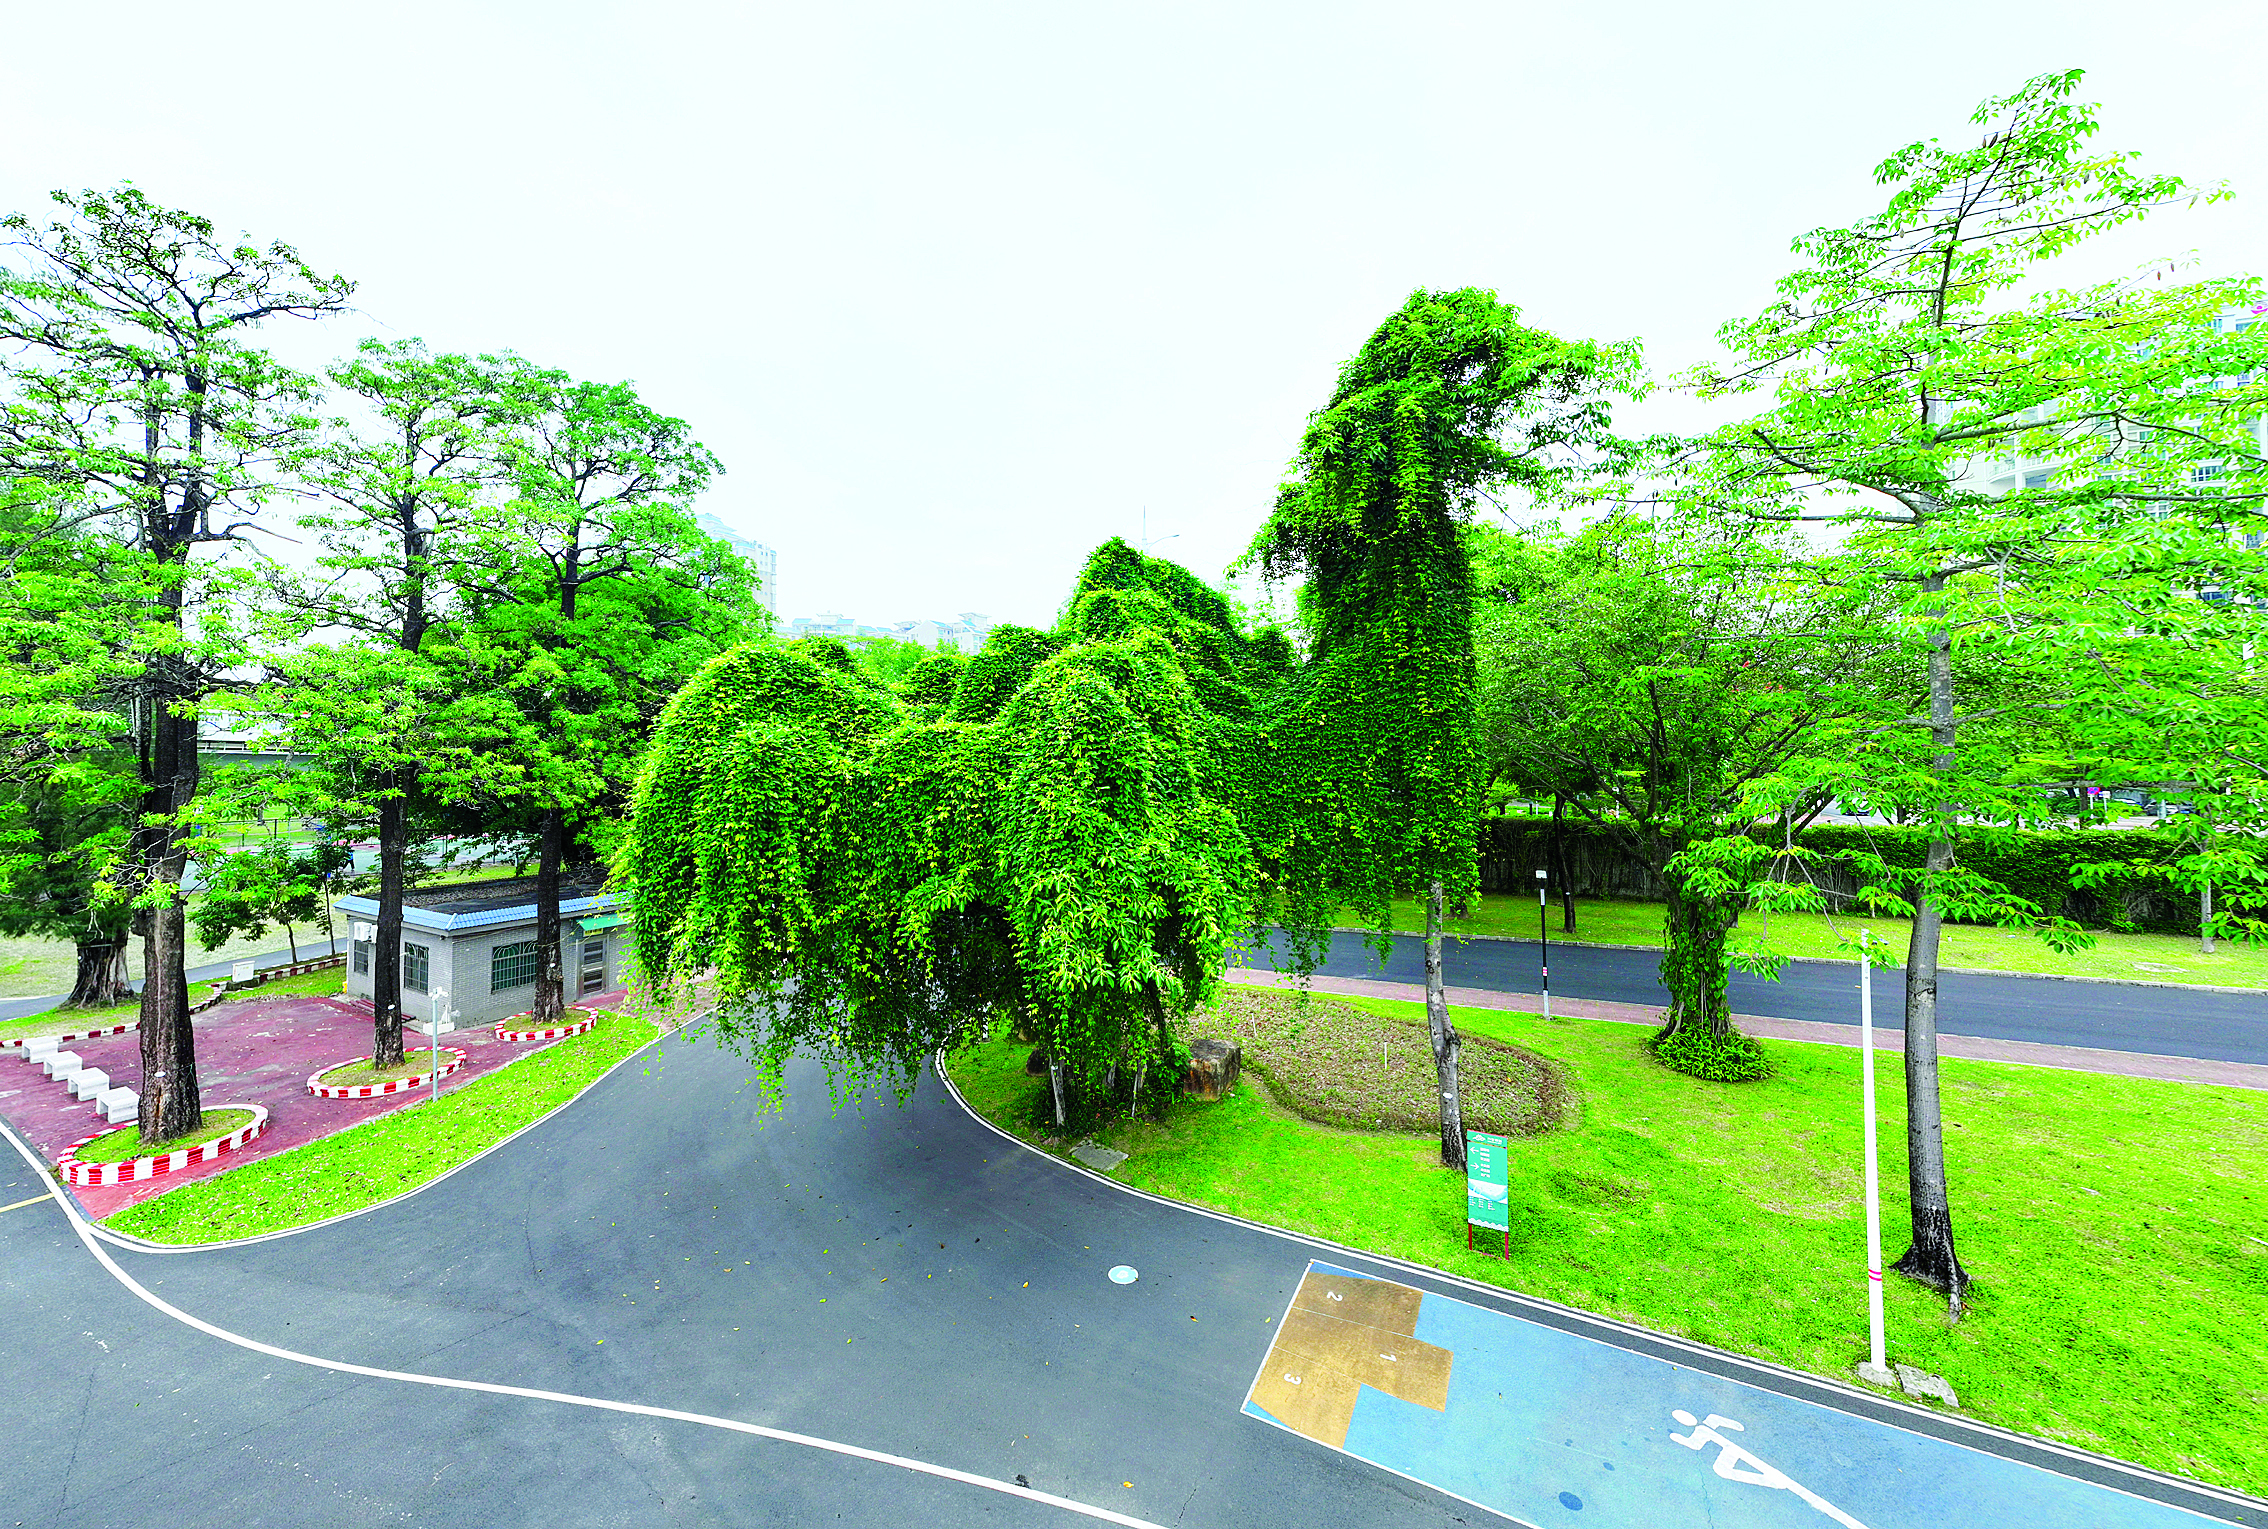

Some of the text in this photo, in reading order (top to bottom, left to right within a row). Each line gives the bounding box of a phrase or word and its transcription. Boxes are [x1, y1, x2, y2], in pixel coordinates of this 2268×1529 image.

[1326, 1290, 1343, 1302] 2
[1379, 1353, 1397, 1362] 1
[1283, 1373, 1302, 1385] 3
